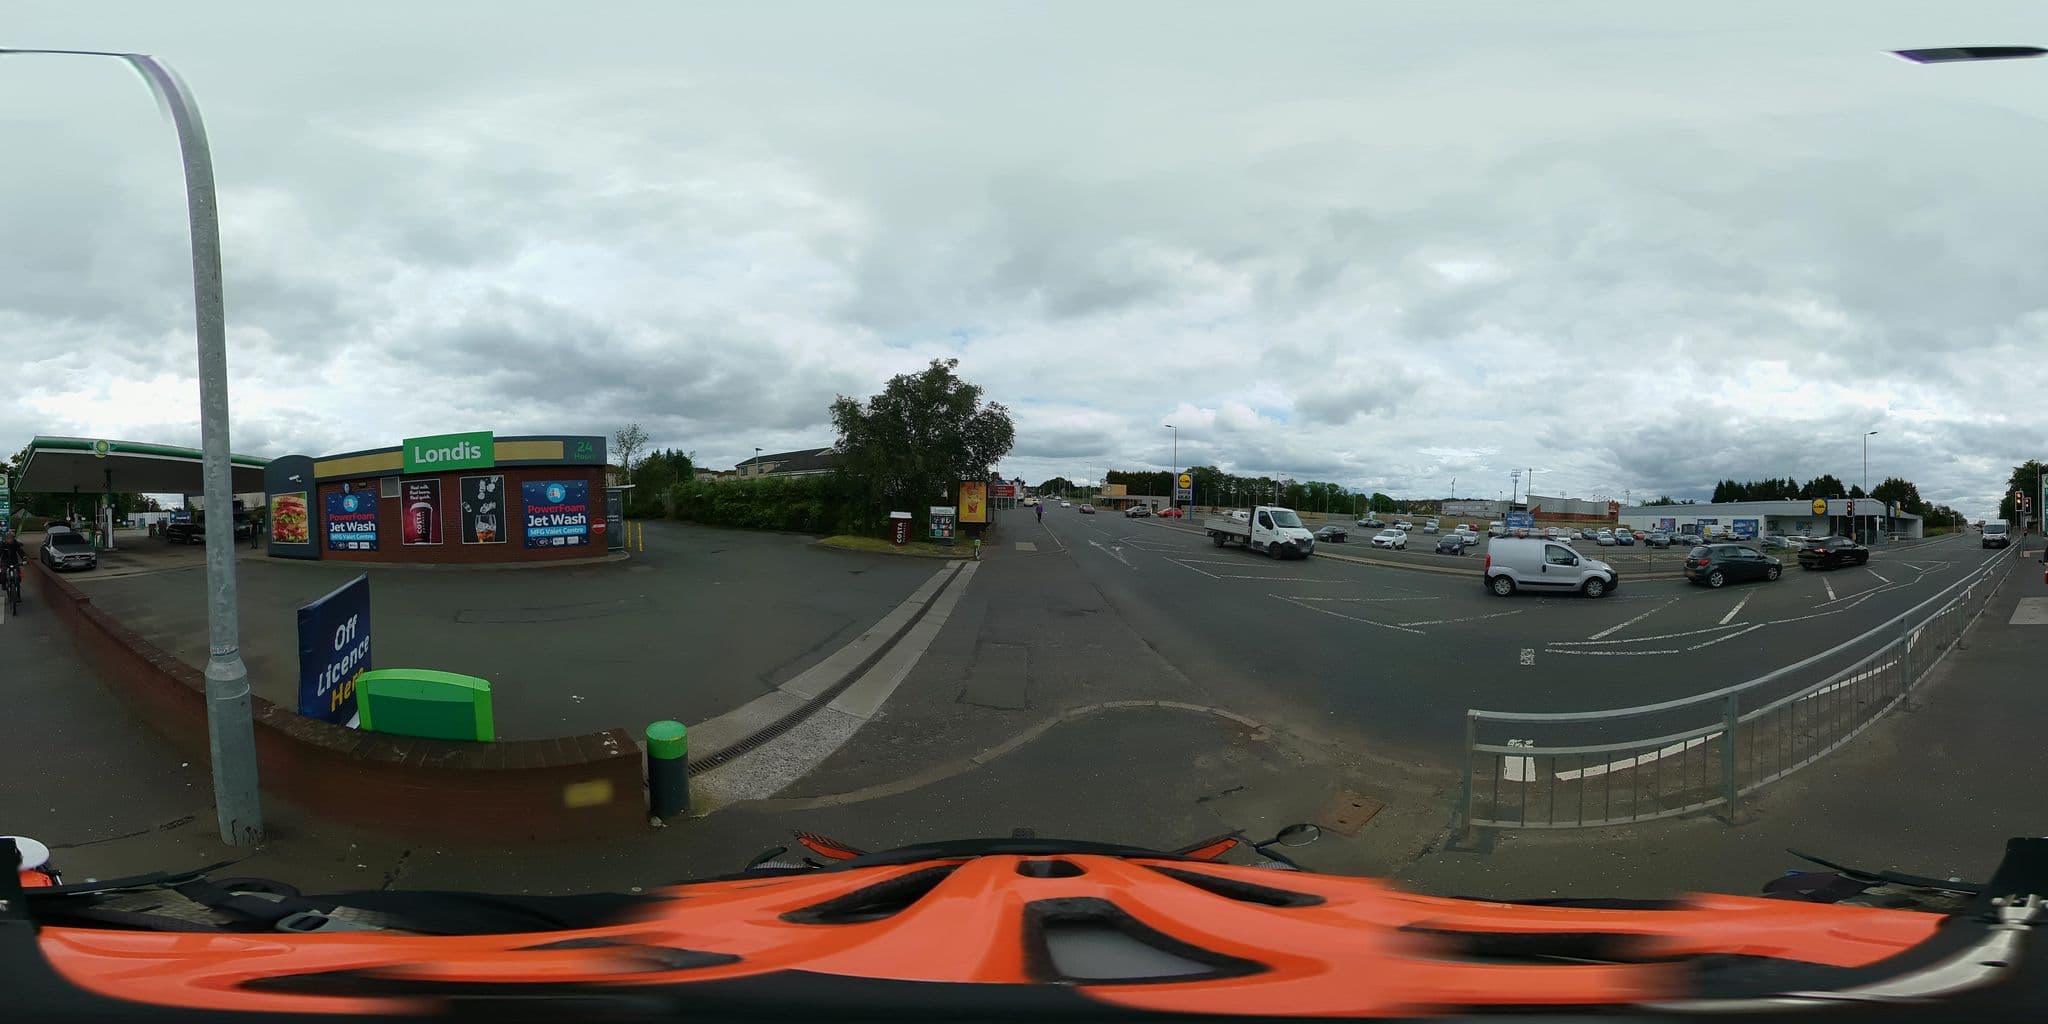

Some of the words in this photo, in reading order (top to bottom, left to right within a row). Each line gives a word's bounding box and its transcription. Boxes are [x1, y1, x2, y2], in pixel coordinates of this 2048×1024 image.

[414, 441, 482, 464] Londis
[577, 441, 593, 452] 24
[527, 504, 586, 513] PowerFoam
[330, 522, 345, 532] Jet
[346, 521, 376, 531] Wash
[528, 515, 549, 527] Jet
[550, 513, 586, 525] Wash
[335, 614, 358, 651] Off
[317, 635, 370, 697] Licence
